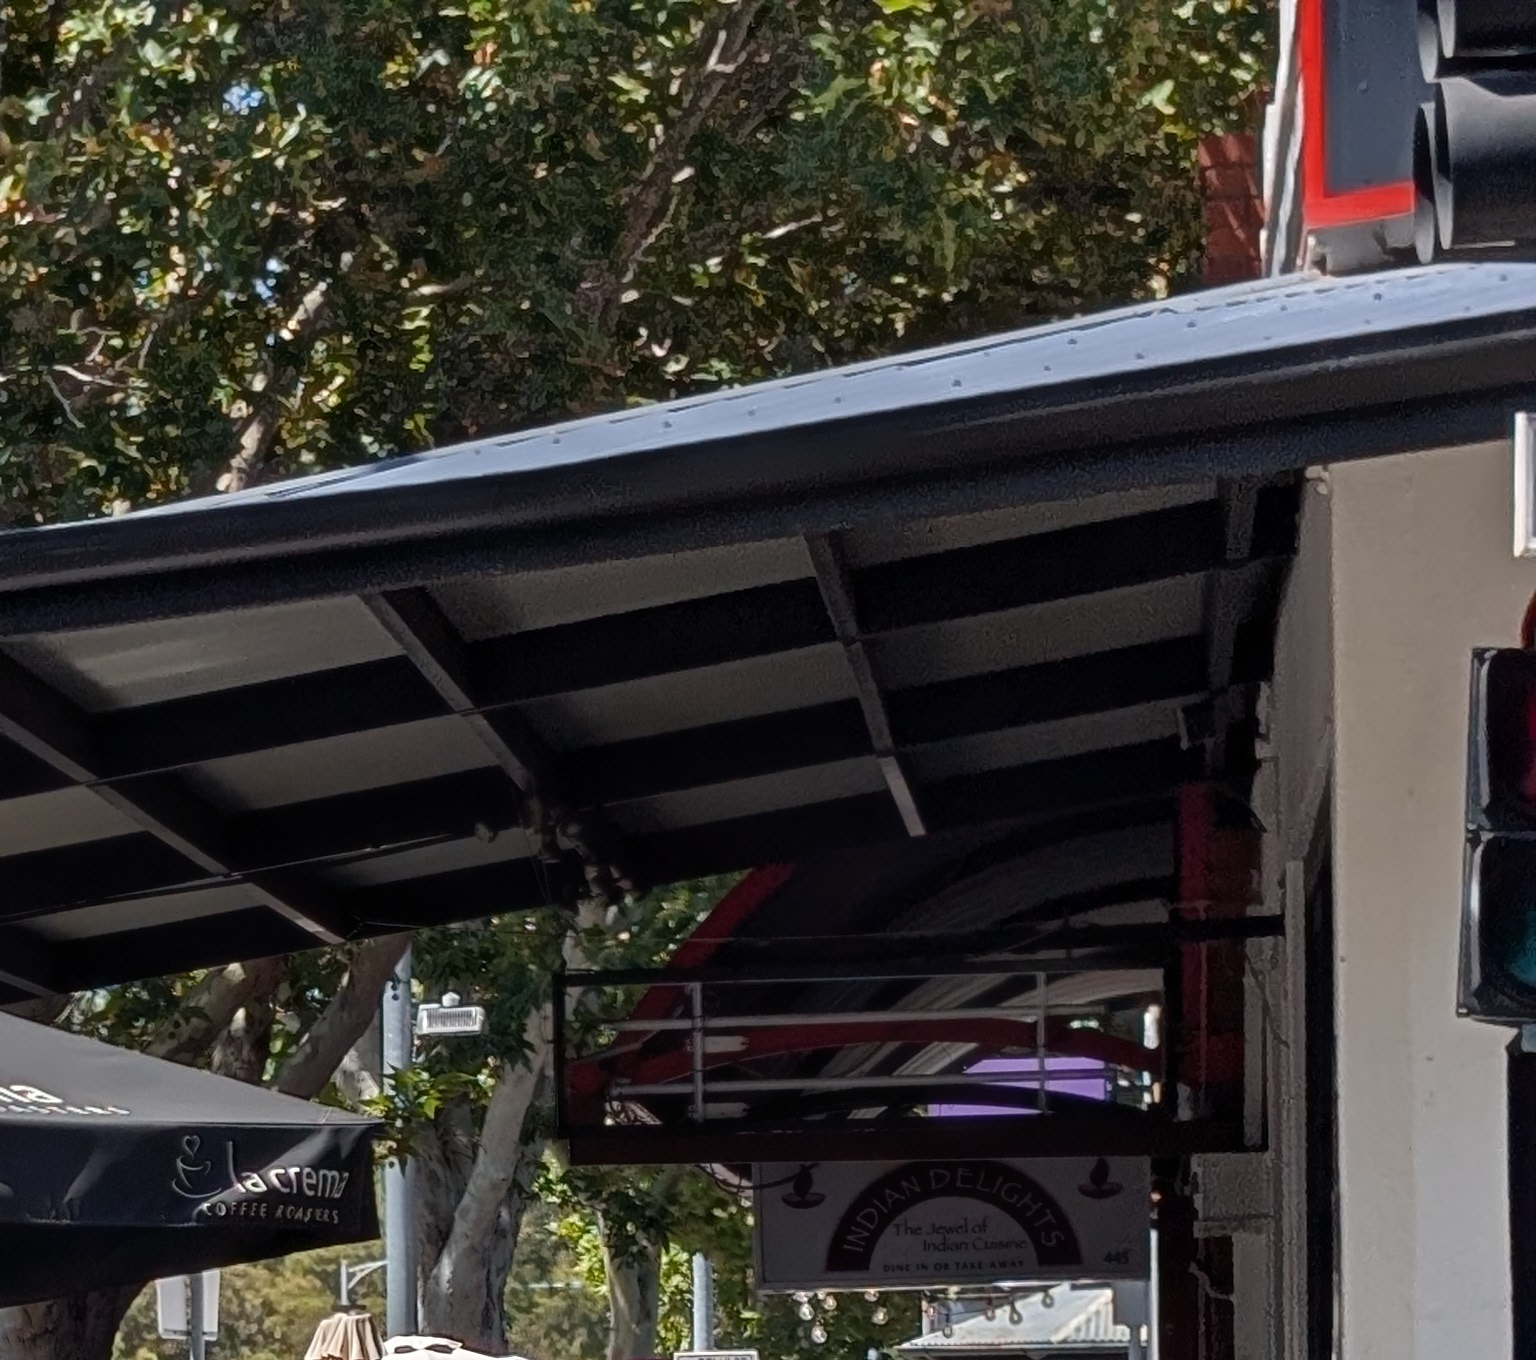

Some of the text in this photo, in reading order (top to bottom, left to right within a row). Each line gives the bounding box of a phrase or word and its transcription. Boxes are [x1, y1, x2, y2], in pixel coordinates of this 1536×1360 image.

[203, 1202, 267, 1217] COFFEE
[843, 1168, 1064, 1253] INDIAN DELIGHTS
[893, 1217, 990, 1237] The Jewel of
[922, 1235, 968, 1252] Indian
